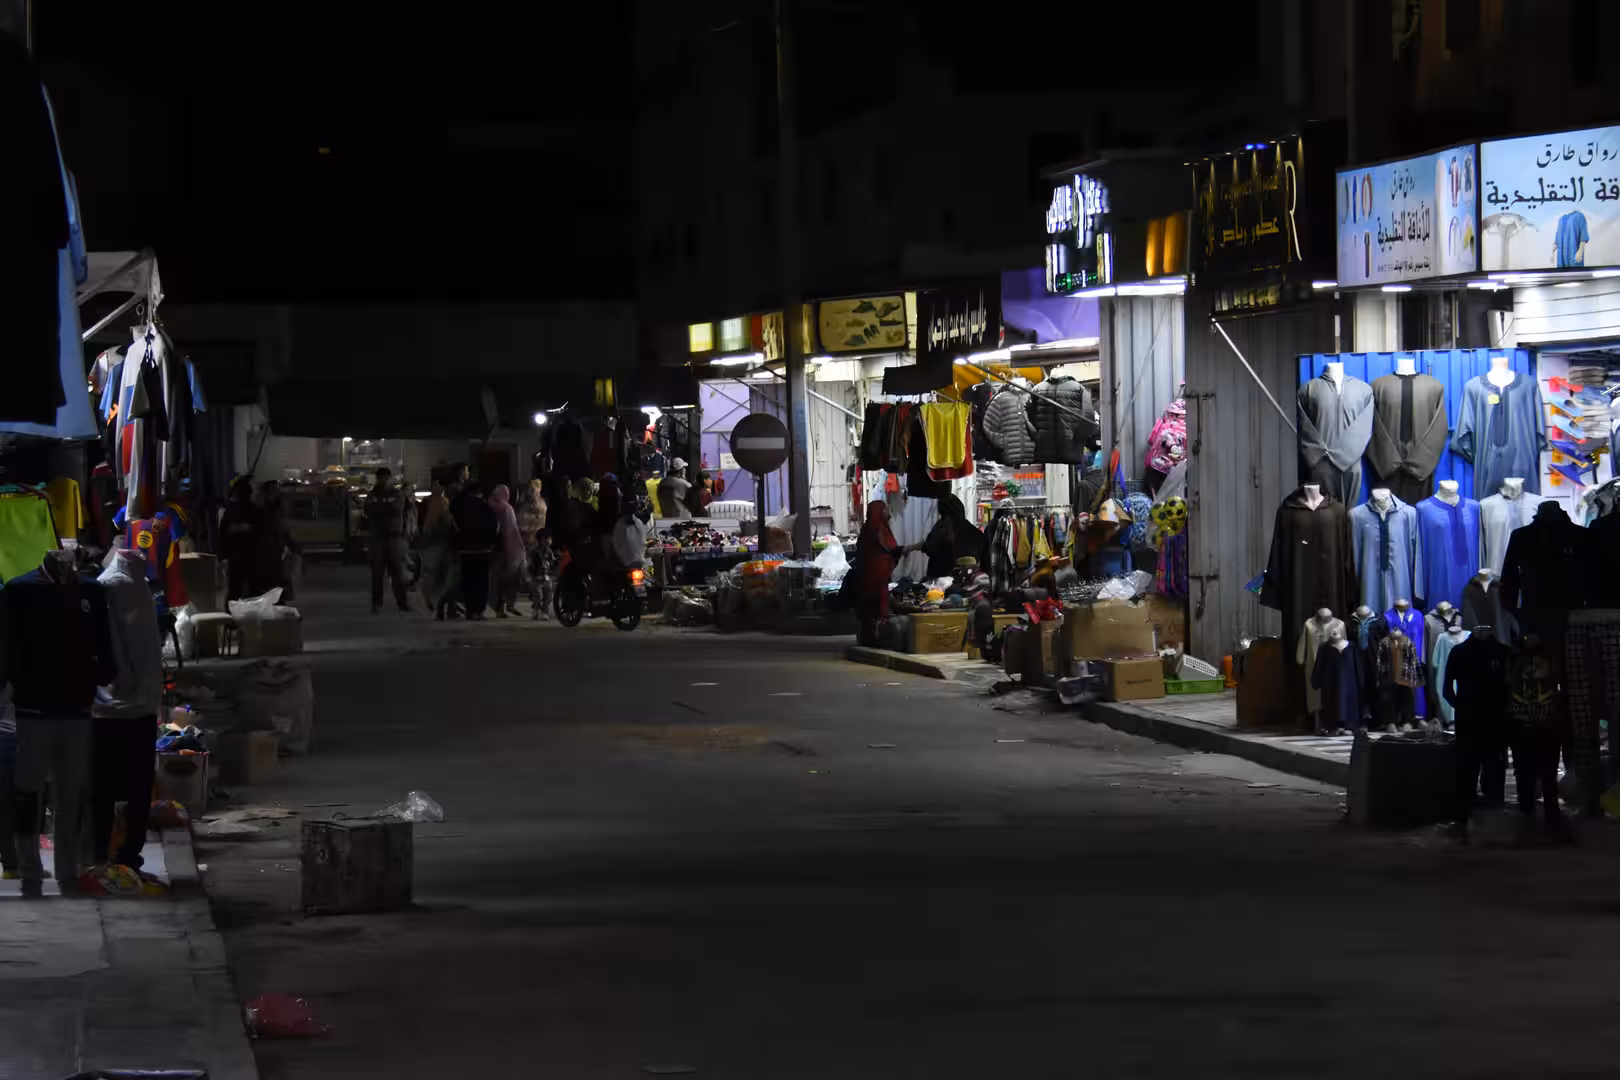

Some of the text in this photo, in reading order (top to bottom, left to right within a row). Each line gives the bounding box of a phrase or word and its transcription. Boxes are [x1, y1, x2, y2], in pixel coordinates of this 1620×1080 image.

[1536, 140, 1619, 168] رواق طارق
[1486, 176, 1584, 211] التقليدية
[1377, 200, 1431, 252] للأناقة التقليدية
